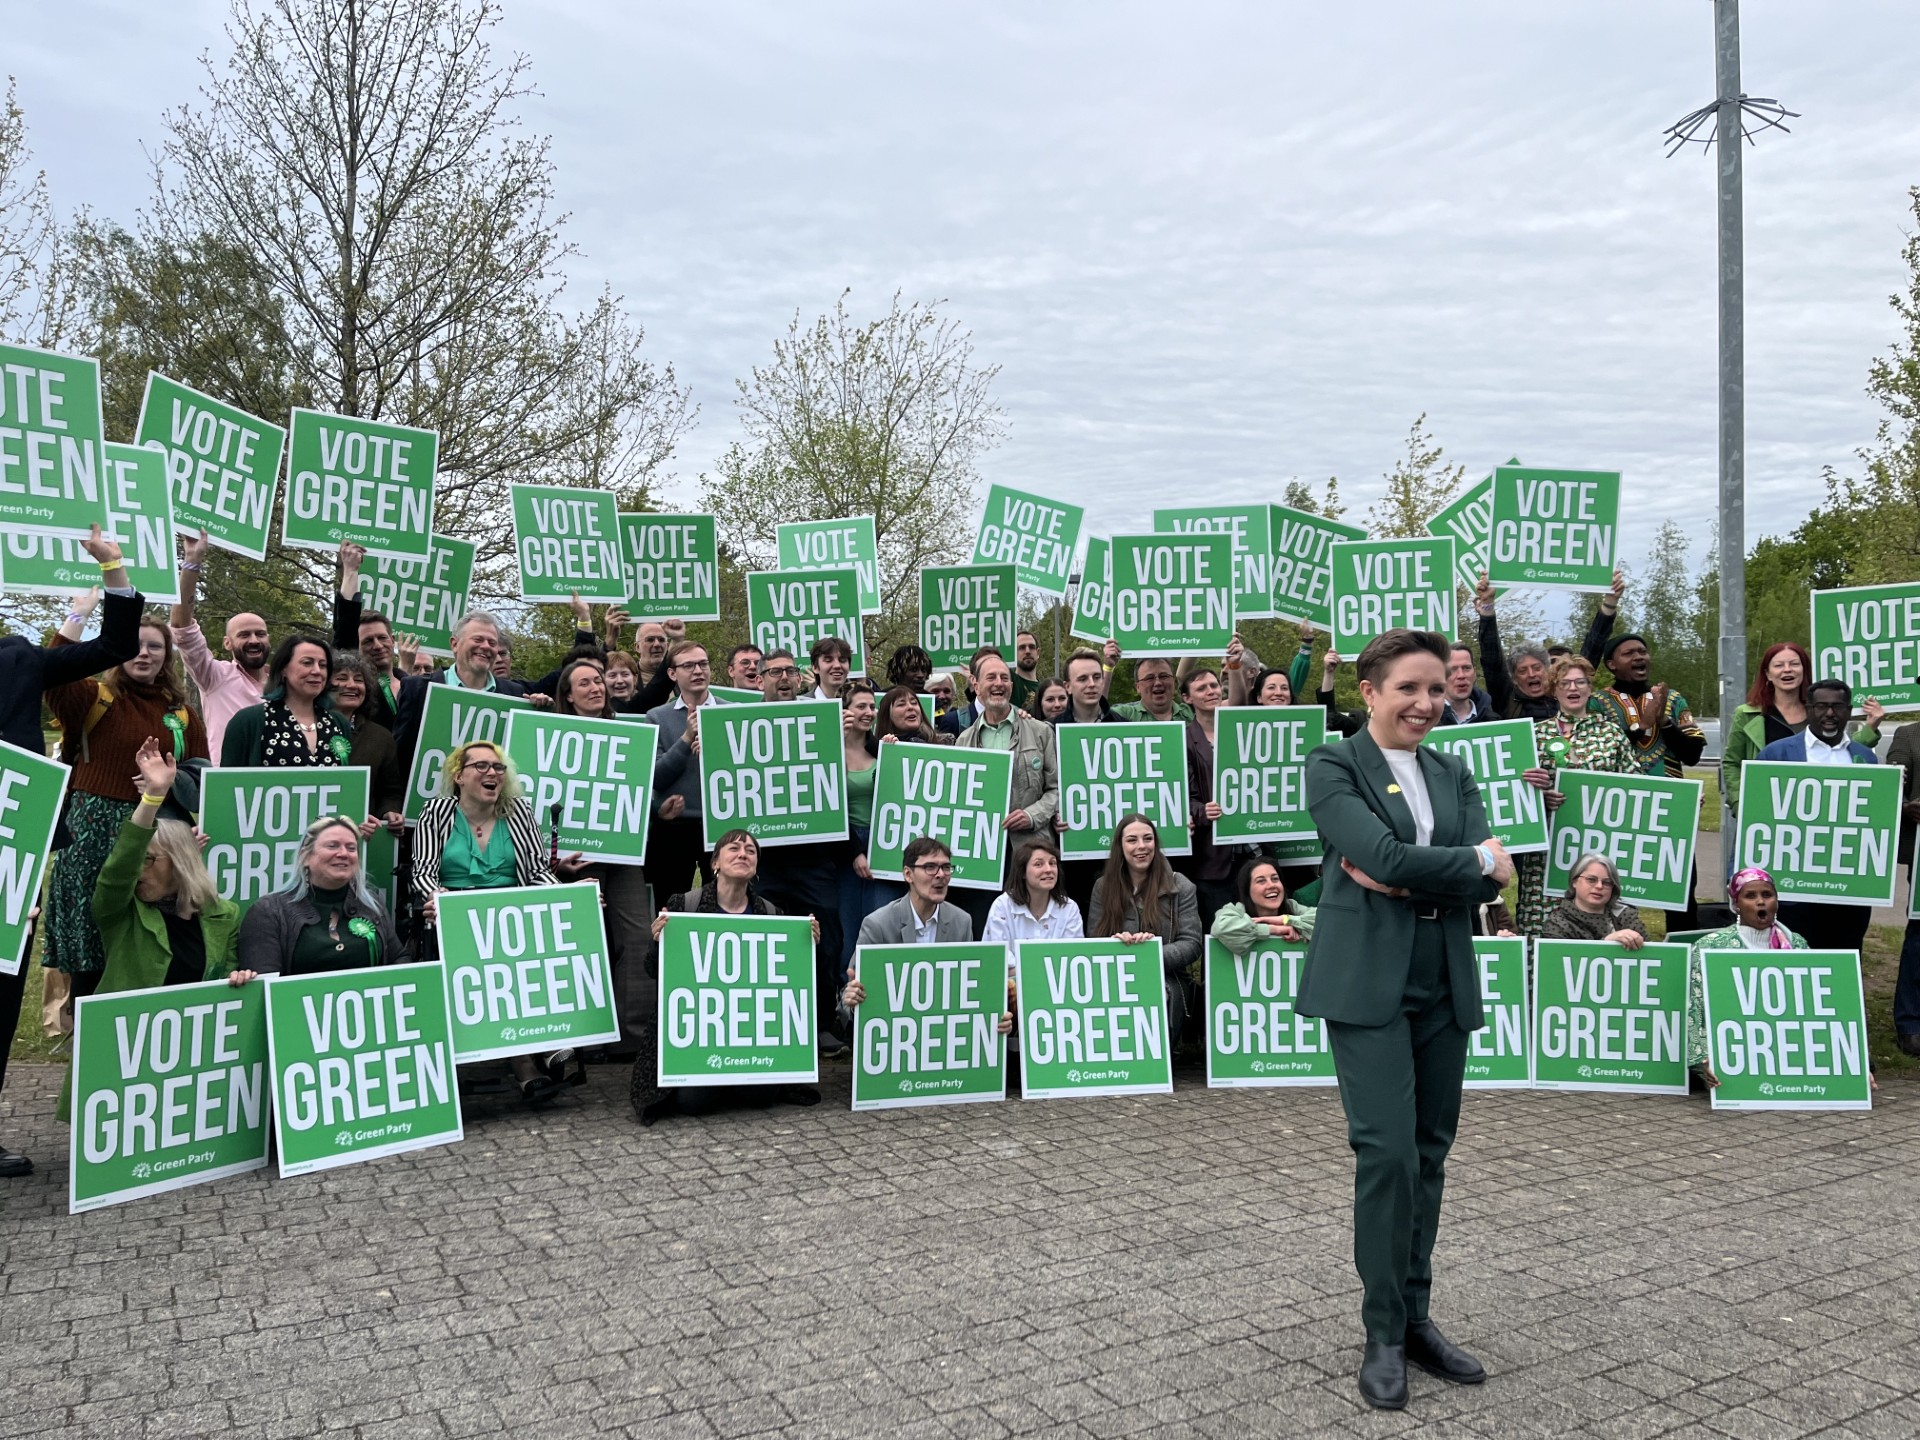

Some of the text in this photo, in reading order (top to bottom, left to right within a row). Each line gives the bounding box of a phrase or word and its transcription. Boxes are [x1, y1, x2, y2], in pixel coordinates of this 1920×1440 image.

[0, 363, 68, 430] TE
[172, 398, 260, 473] VOTE
[320, 427, 412, 482] VOTE
[0, 427, 98, 502] EEN
[0, 505, 54, 519] reen Party
[293, 470, 427, 535] GREEN
[531, 498, 601, 536] VOTE
[1004, 496, 1066, 539] VOTE
[1516, 480, 1597, 520] VOTE
[183, 512, 228, 534] Green Party
[344, 531, 390, 546] Green Party
[629, 525, 697, 559] VOTE
[794, 528, 858, 563] VOTE
[1495, 520, 1611, 566] GREEN
[523, 536, 619, 579] GREEN
[980, 524, 1070, 578] GREEN
[1133, 546, 1211, 585] VOTE
[1353, 551, 1432, 590] VOTE
[564, 583, 598, 593] Green Party
[623, 561, 711, 600] GREEN
[938, 575, 999, 611] VOTE
[1026, 574, 1040, 583] Party
[1272, 554, 1330, 607] REE
[1538, 570, 1578, 580] Green Party
[672, 604, 688, 613] Party
[768, 581, 840, 617] VOTE
[1118, 588, 1227, 631] GREEN
[1281, 602, 1314, 616] Green Party
[1338, 591, 1450, 636] GREEN
[1836, 596, 1920, 642] VOTE
[924, 610, 1012, 652] GREEN
[1182, 638, 1200, 646] Party
[1820, 640, 1920, 688] GREE
[1891, 692, 1910, 700] Party
[537, 728, 629, 779] VOTE
[725, 716, 818, 764] VOTE
[1081, 737, 1163, 779] VOTE
[1236, 720, 1306, 764] VOTE
[710, 763, 839, 819] GREEN
[903, 758, 986, 806] VOTE
[1220, 766, 1306, 816] GREE
[1770, 777, 1872, 823] VOTE
[234, 784, 341, 838] VOTE
[762, 822, 808, 832] Green Party
[1065, 782, 1182, 831] GREEN
[1258, 820, 1294, 828] Green Party
[1582, 785, 1672, 832] VOTE
[582, 837, 603, 848] Party
[876, 802, 1000, 860] GREEN
[1745, 822, 1890, 876] GREEN
[208, 841, 300, 900] GRE
[1554, 826, 1687, 883] GREEN
[1626, 884, 1646, 894] Party
[1797, 880, 1848, 892] Green Party
[468, 902, 577, 959] VOTE
[690, 932, 787, 983] VOTE
[1044, 955, 1138, 1004] VOTE
[1233, 951, 1308, 998] VOT
[453, 953, 605, 1025] GREEN
[885, 960, 980, 1011] VOTE
[1563, 957, 1661, 1005] VOTE
[1732, 967, 1835, 1015] VOTE
[116, 1000, 242, 1079] VOTE
[303, 984, 420, 1053] VOTE
[518, 1022, 571, 1038] Green Party
[669, 988, 808, 1048] GREEN
[1029, 1006, 1161, 1064] GREEN
[1214, 1001, 1326, 1056] GREE
[1542, 1006, 1680, 1062] GREEN
[724, 1056, 774, 1067] Green Party
[862, 1012, 998, 1075] GREEN
[1717, 1020, 1860, 1075] GREEN
[283, 1042, 449, 1131] GREEN
[915, 1078, 963, 1090] Green Party
[1082, 1069, 1130, 1080] Green Party
[1266, 1061, 1312, 1072] Green Party
[1469, 1065, 1490, 1074] Party
[1594, 1068, 1644, 1079] Green Party
[1776, 1084, 1826, 1096] Green Party
[83, 1062, 262, 1164] GREEN
[354, 1122, 412, 1142] Green Party
[153, 1150, 216, 1172] Green Party
